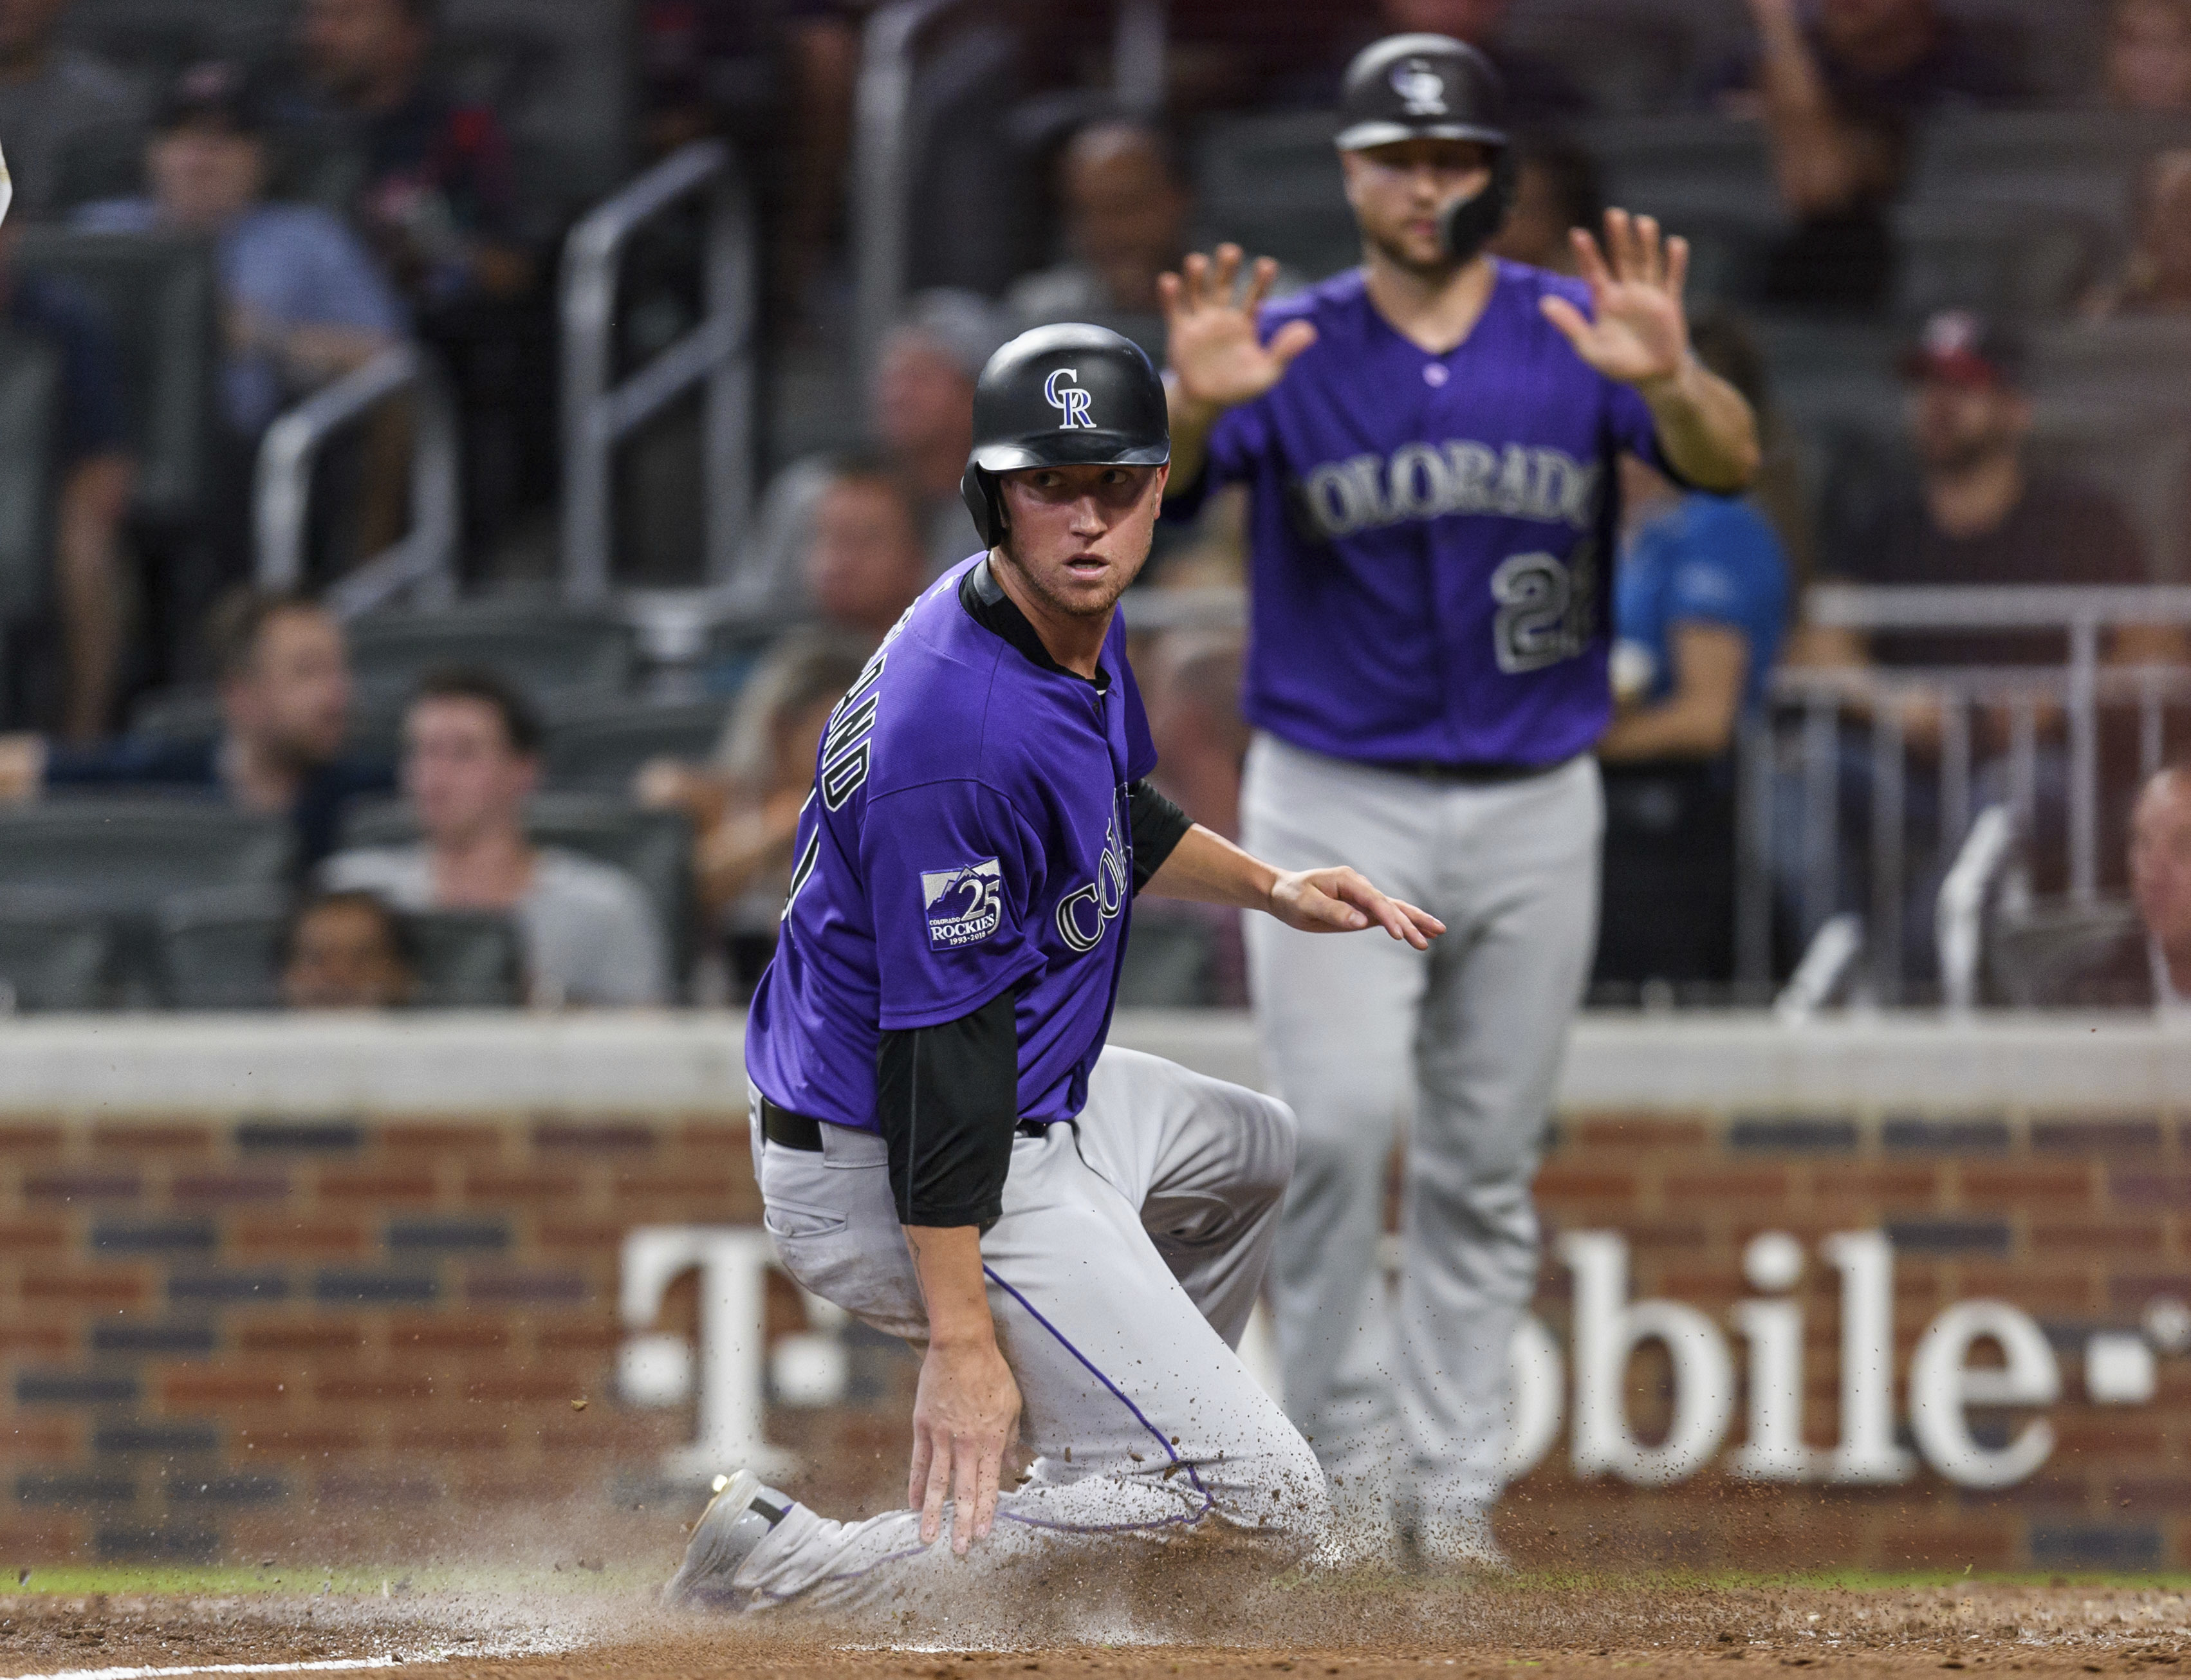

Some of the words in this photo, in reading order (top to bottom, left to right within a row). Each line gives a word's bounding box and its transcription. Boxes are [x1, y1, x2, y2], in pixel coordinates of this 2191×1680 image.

[1044, 368, 1097, 430] CR
[1293, 439, 1601, 539] OLORAD
[929, 916, 961, 926] COLORADO
[930, 913, 995, 941] ROCKIES
[959, 879, 1001, 935] 25
[948, 930, 986, 945] 1993-2018
